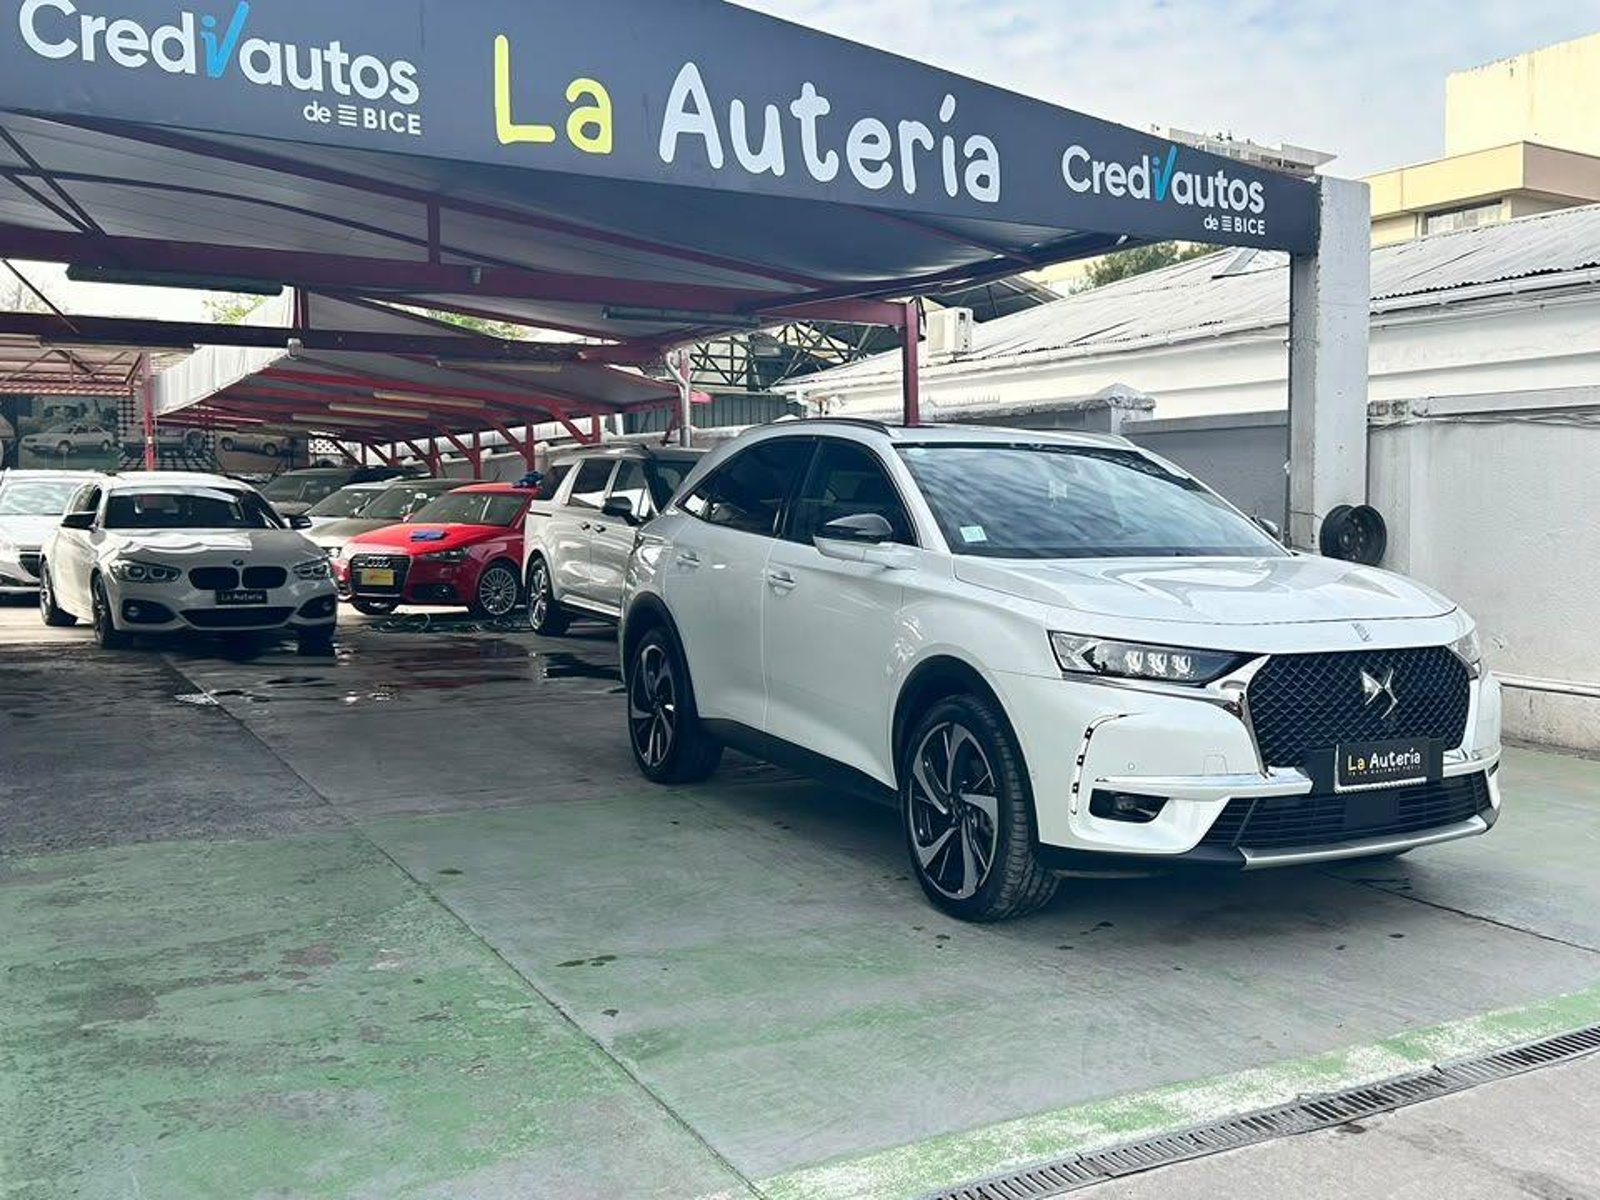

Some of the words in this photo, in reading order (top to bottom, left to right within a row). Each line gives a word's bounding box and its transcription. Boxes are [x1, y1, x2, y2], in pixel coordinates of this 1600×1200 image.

[303, 101, 332, 123] de
[364, 109, 421, 136] BICE
[493, 34, 612, 154] La
[658, 62, 1001, 203] Autería
[1204, 214, 1219, 231] de
[1234, 216, 1266, 236] BICE
[1347, 755, 1366, 771] La
[1369, 747, 1421, 769] Autería
